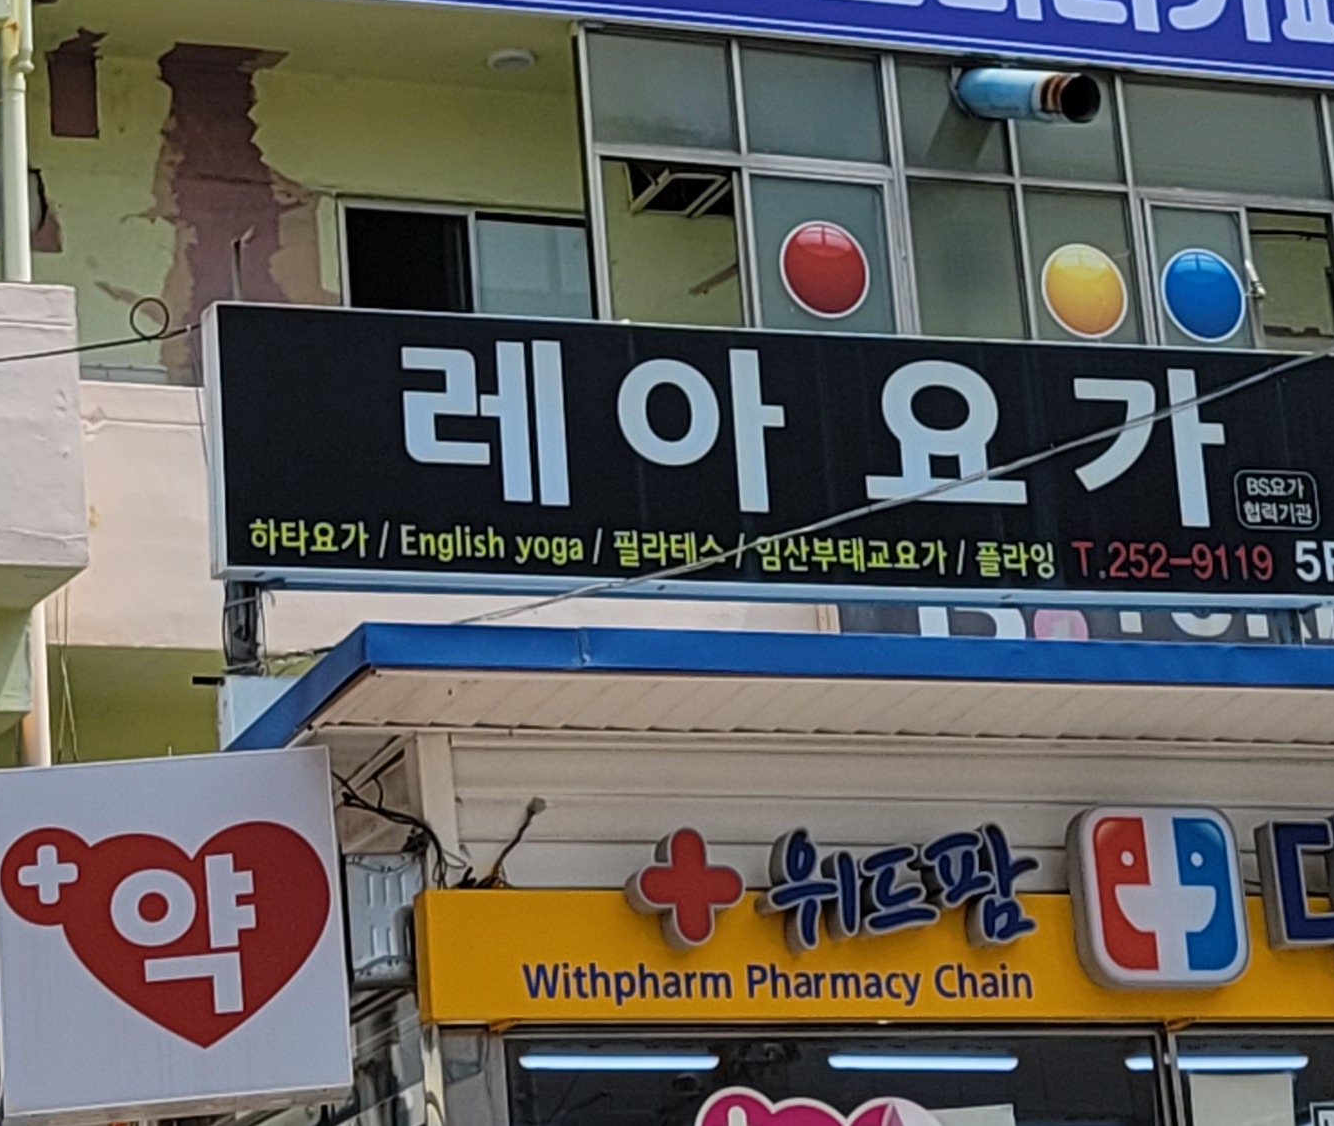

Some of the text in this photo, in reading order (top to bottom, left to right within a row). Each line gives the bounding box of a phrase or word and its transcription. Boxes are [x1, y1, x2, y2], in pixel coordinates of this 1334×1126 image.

[1246, 476, 1305, 500] BS요가
[249, 517, 370, 558] 하타요가
[399, 524, 506, 563] English
[514, 534, 584, 566] yoga
[613, 530, 727, 567] 필라테스
[754, 535, 948, 575] 임산부태교요가
[974, 541, 1056, 579] 플라잉
[1071, 540, 1274, 581] T.252-9119
[769, 823, 1040, 949] 위드팜
[109, 852, 258, 1015] 약
[522, 961, 1034, 1007] Withpharm Pharmacy Chain
